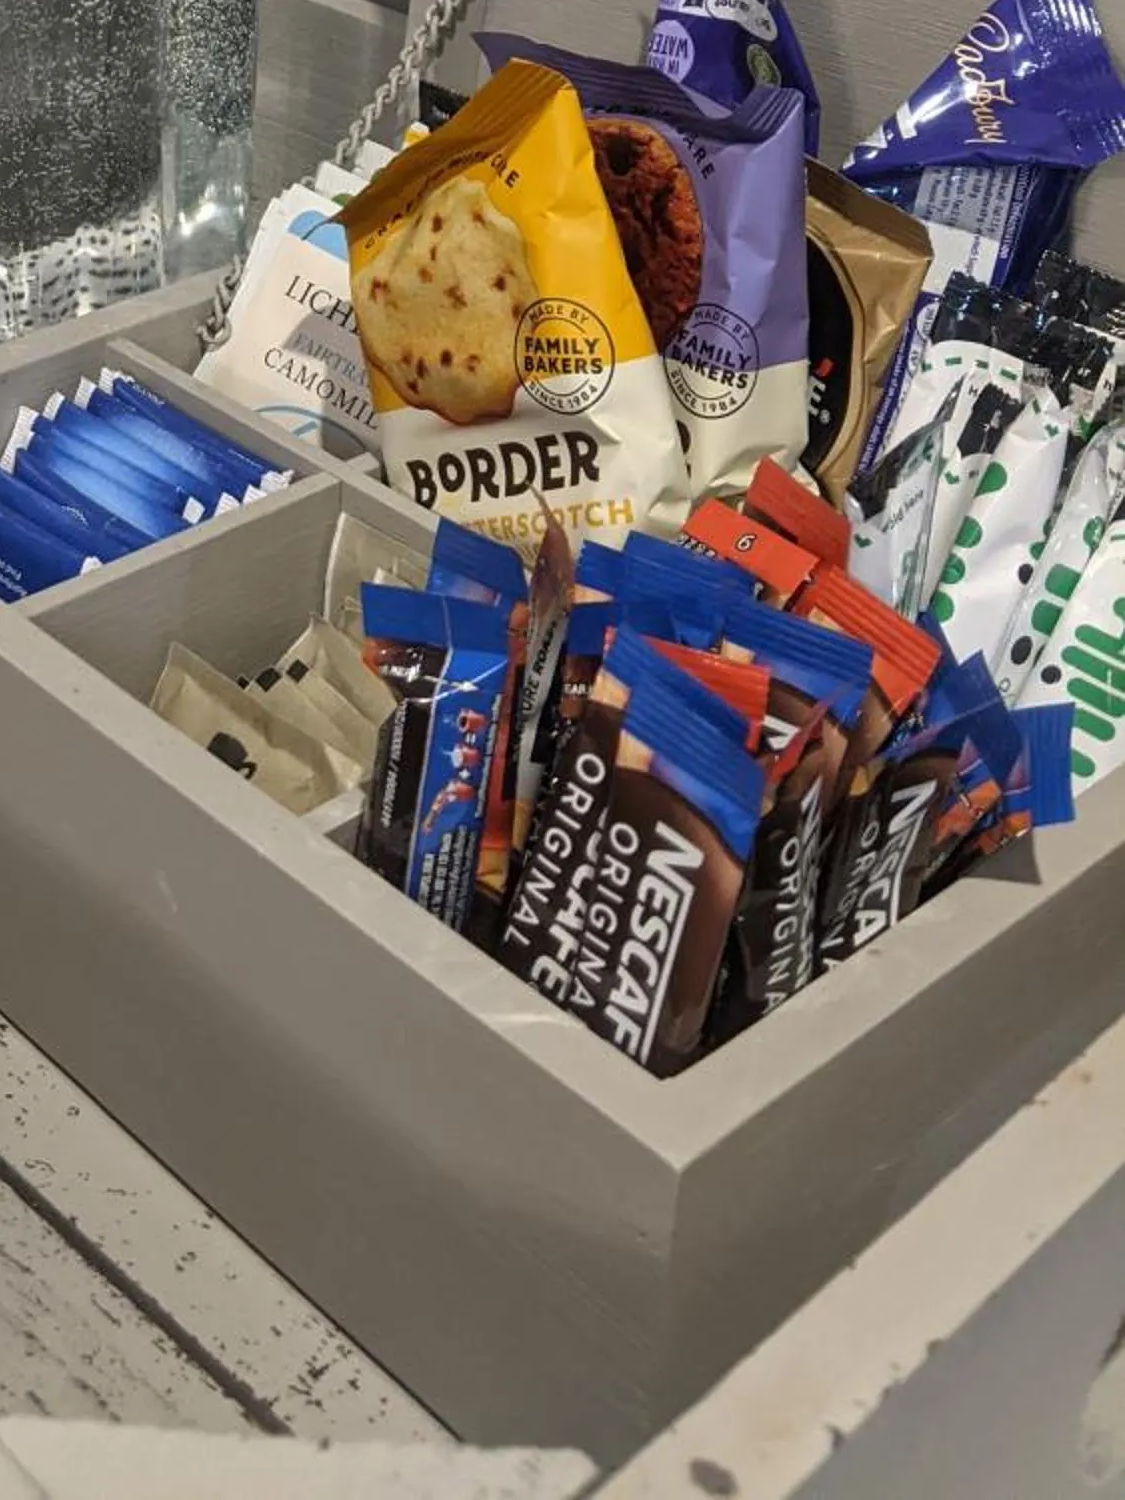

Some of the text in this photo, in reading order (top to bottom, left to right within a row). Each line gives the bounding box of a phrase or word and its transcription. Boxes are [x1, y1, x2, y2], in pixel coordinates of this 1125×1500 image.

[954, 10, 1014, 143] Cadbury
[680, 132, 715, 180] ARE
[528, 304, 590, 325] MADE BY
[694, 310, 751, 340] MADE BY
[524, 336, 601, 355] FAMILY
[524, 355, 604, 375] BAKERS
[671, 343, 749, 389] BAKERS
[676, 328, 752, 371] FAMILY
[528, 380, 564, 409] SINCE
[702, 397, 737, 413] 1984
[406, 430, 600, 509] BORDER
[503, 752, 607, 947] ORIGINAL
[570, 822, 640, 1008] ORIGINA
[605, 819, 705, 1065] NESCAF
